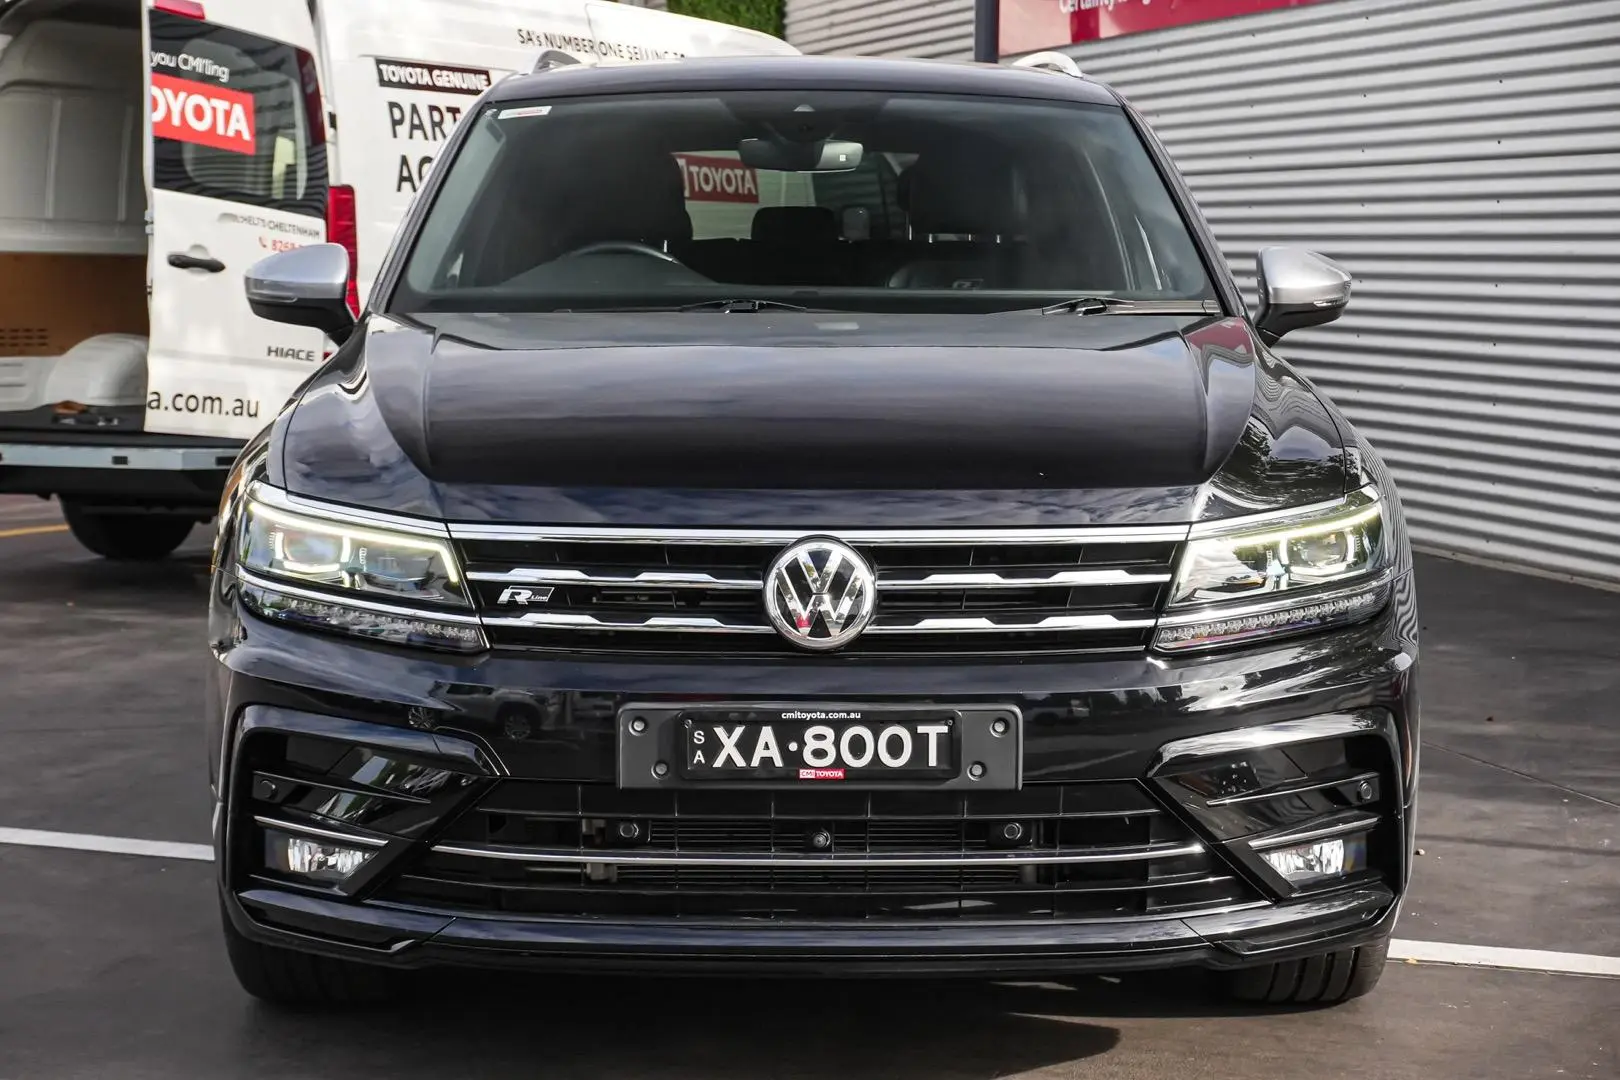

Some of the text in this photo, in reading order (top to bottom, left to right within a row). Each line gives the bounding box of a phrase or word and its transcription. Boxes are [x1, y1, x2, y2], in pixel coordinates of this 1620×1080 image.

[517, 29, 542, 47] SA's
[544, 32, 594, 54] NUMBER
[599, 41, 625, 58] ONE
[151, 51, 177, 67] you
[379, 64, 489, 91] TOYOTA GENUINE
[689, 165, 757, 195] TOYOTA
[266, 346, 315, 361] HIACE
[147, 391, 259, 417] a.com.au
[781, 710, 861, 720] cmitoyota.com.au
[815, 770, 844, 778] TOYOTA
